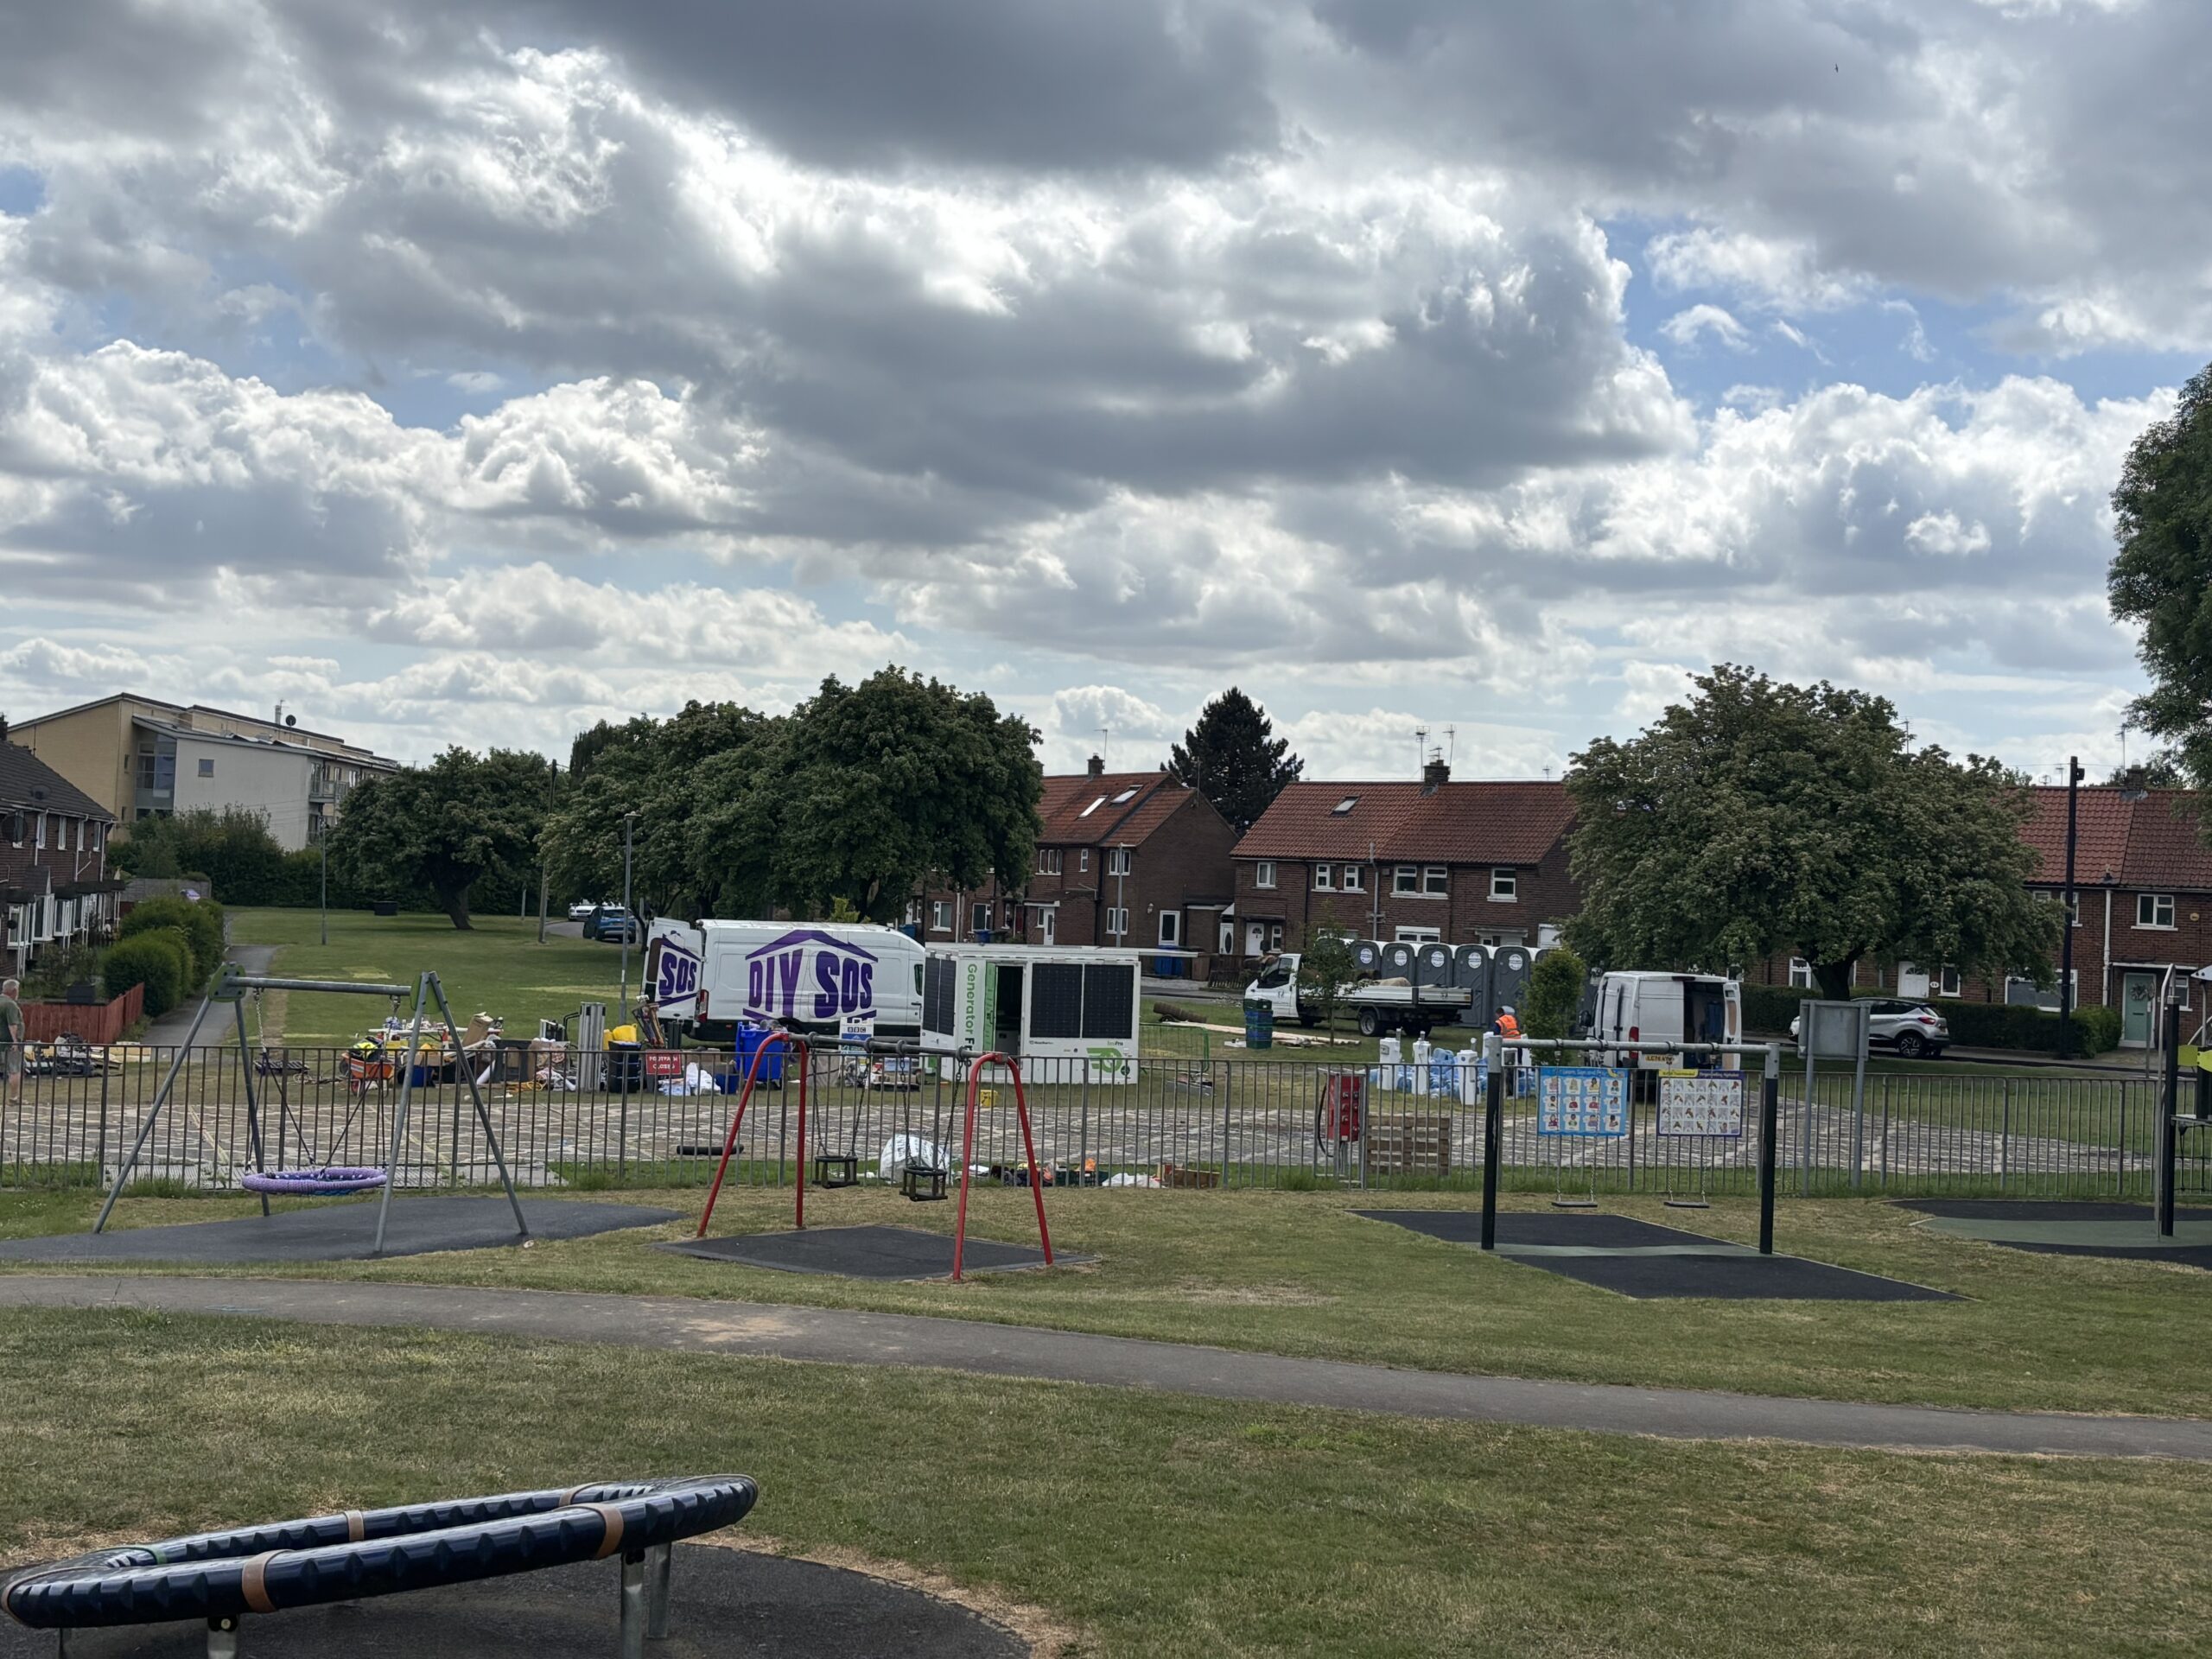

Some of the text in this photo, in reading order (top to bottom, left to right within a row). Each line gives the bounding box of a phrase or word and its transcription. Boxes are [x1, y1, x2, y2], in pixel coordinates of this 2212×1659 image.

[658, 951, 697, 999] SOS
[748, 948, 873, 1019] DIY SOS
[965, 963, 977, 1034] Generator
